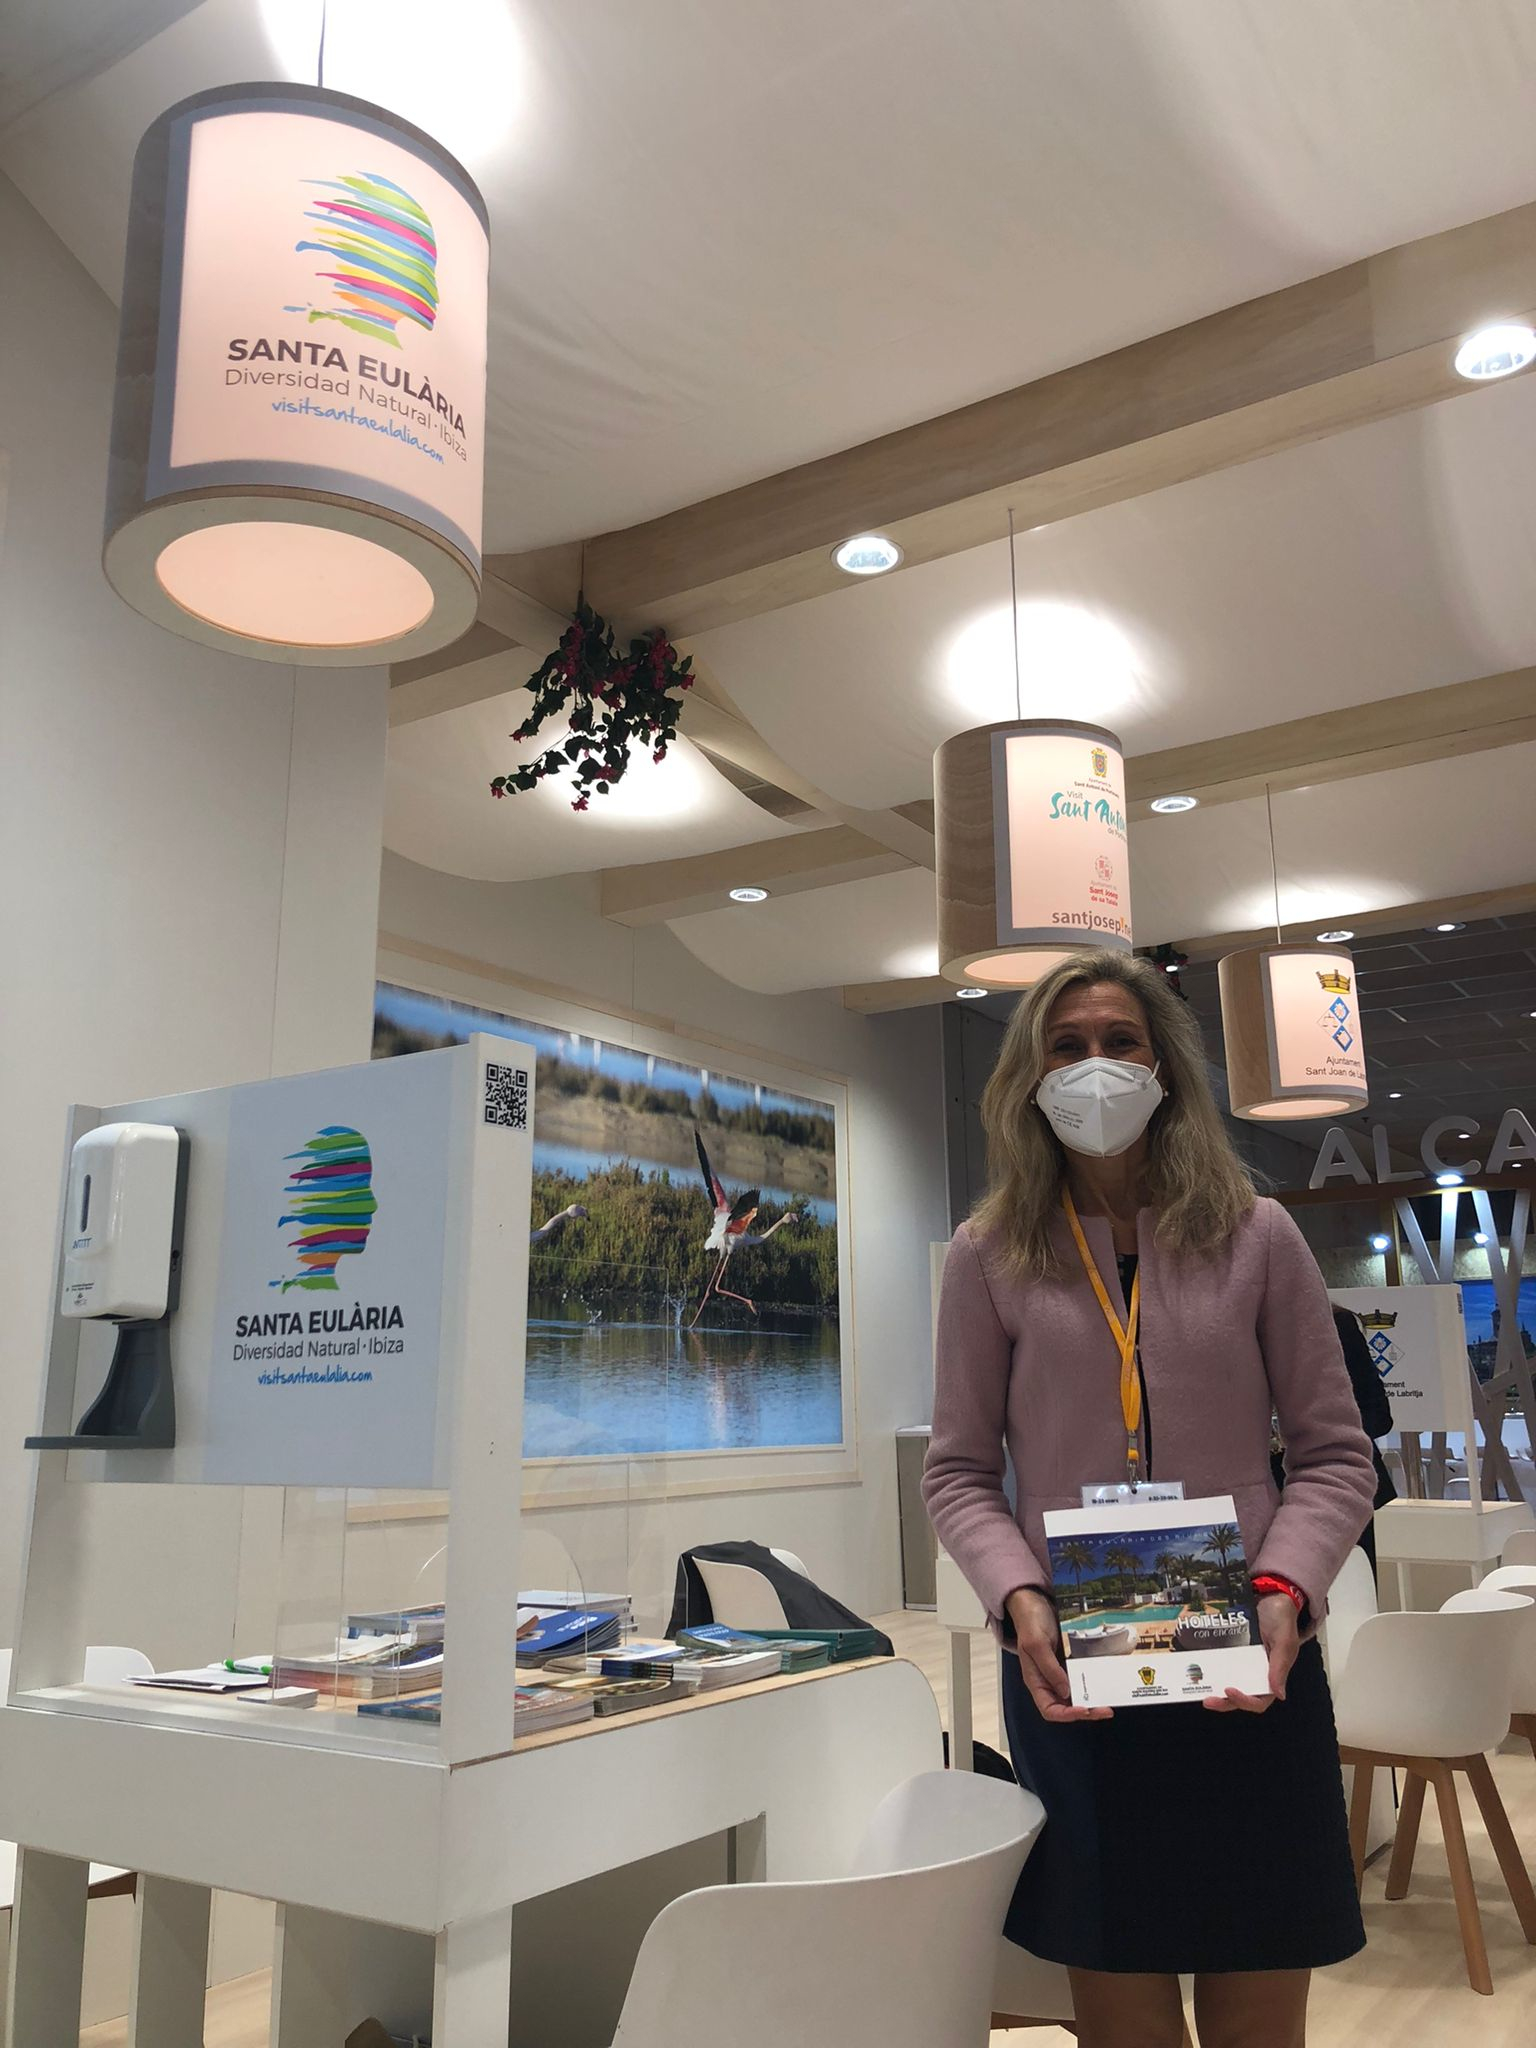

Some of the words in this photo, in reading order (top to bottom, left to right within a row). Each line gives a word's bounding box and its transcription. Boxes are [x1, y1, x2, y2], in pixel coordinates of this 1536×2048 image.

[225, 368, 350, 396] Diversidad
[227, 338, 349, 373] SANTA
[358, 354, 467, 439] EULÀRIA
[1067, 790, 1083, 799] Visit
[1049, 792, 1092, 822] Sant
[1305, 1066, 1327, 1076] Sant
[1328, 1067, 1347, 1077] Joan
[1309, 1108, 1536, 1190] ALCA
[235, 1312, 303, 1338] SANTA
[308, 1301, 404, 1334] EULÀRIA
[233, 1340, 304, 1361] Diversidad
[1178, 1611, 1247, 1630] HOTELES
[1193, 1630, 1210, 1639] con
[1212, 1626, 1248, 1638] encanto
